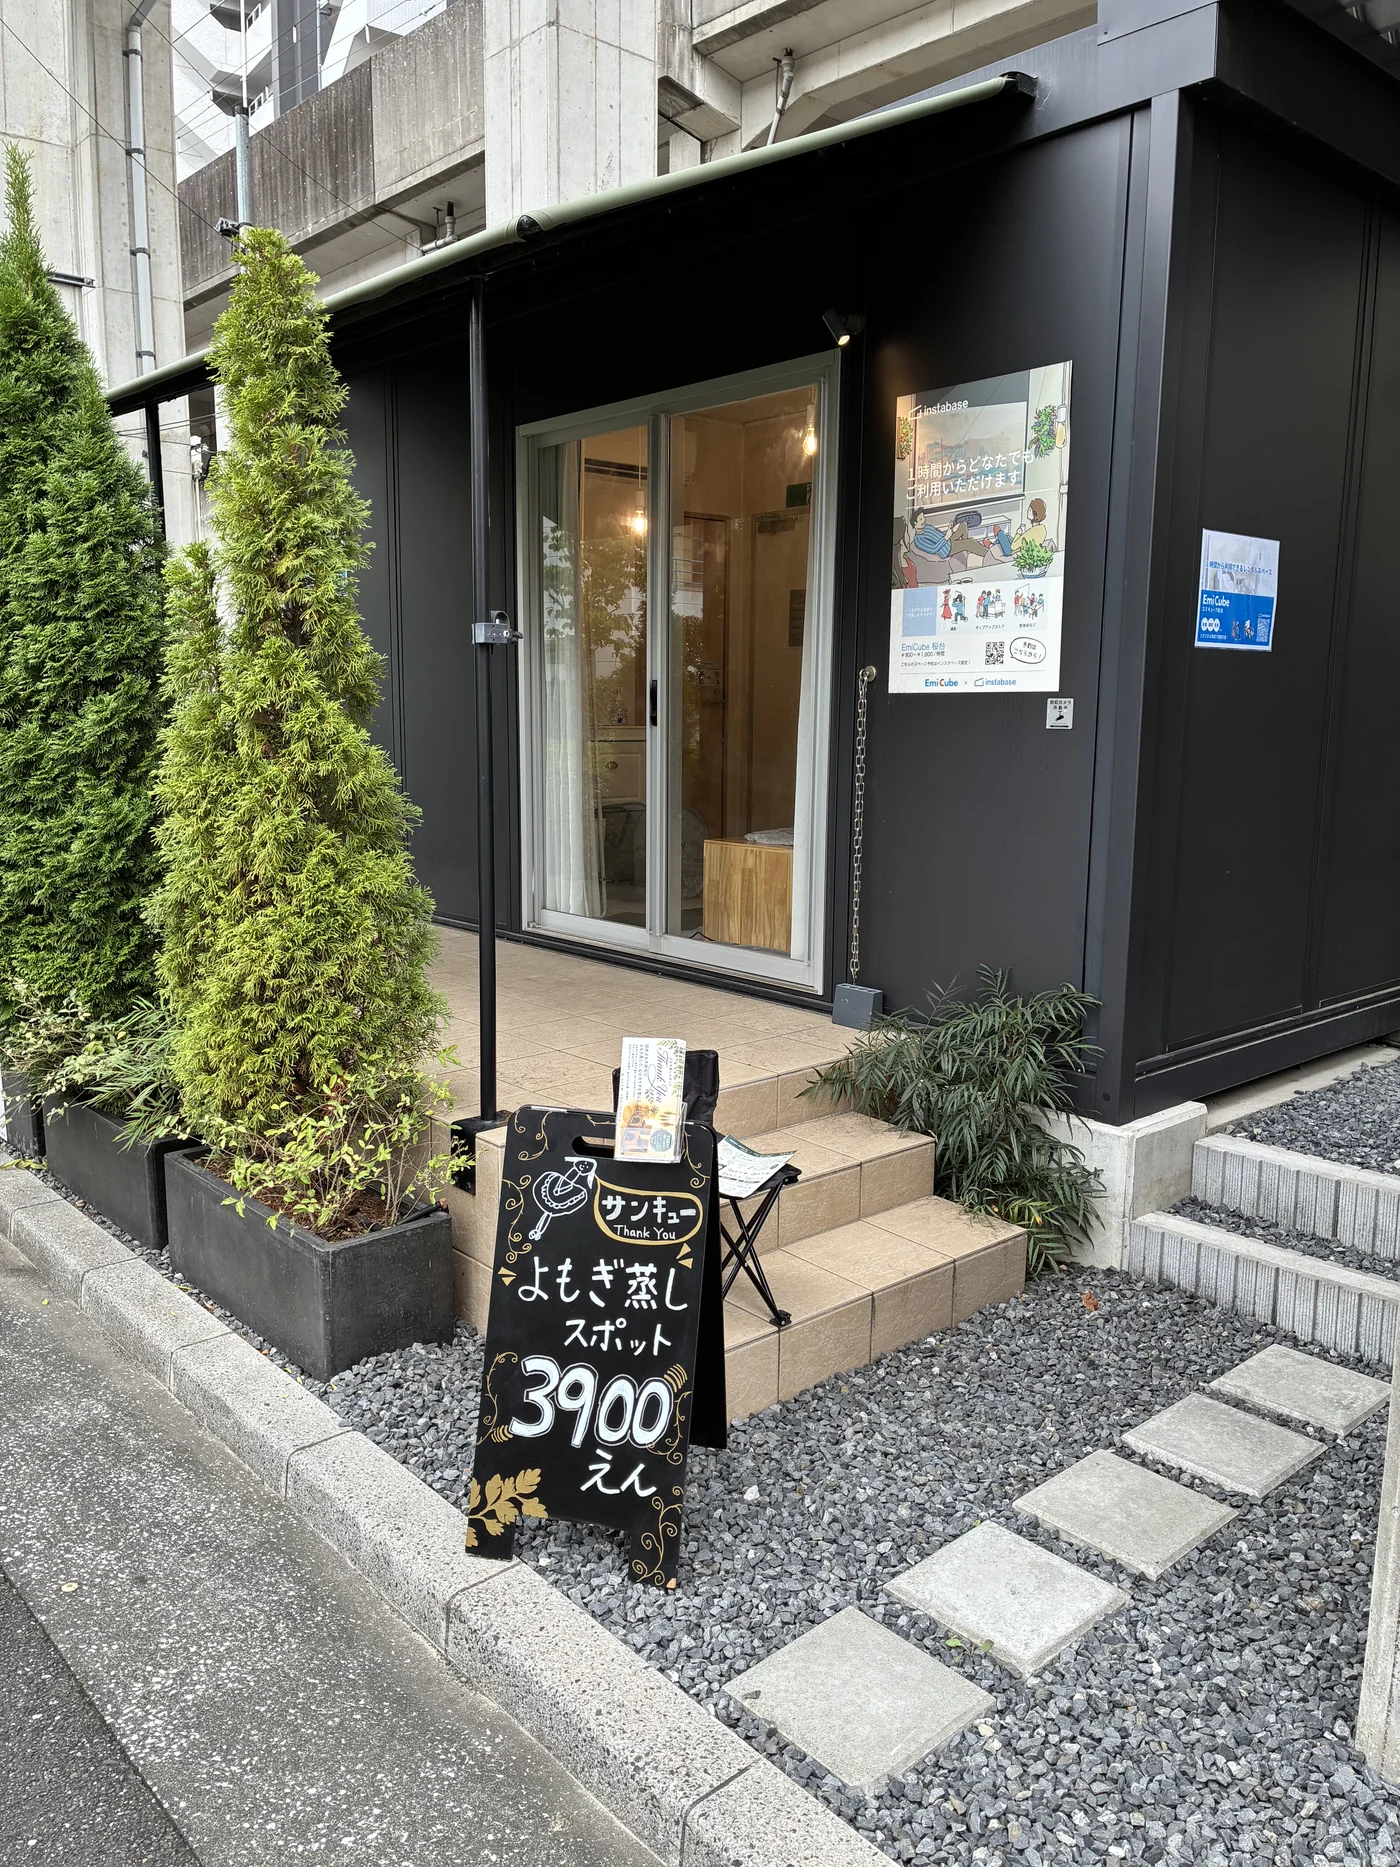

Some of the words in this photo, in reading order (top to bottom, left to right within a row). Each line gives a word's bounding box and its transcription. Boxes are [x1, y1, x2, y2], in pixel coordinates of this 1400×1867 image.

[923, 399, 969, 415] instabase
[908, 450, 1034, 481] 1時間からどなたでも
[906, 470, 1021, 500] ご利用いただけます
[901, 643, 930, 651] EmiCube
[985, 677, 1017, 687] instabase
[601, 1194, 697, 1226] サンキュー
[613, 1224, 651, 1239] Thank
[653, 1225, 677, 1241] You
[517, 1256, 689, 1311] よもぎ蒸し
[563, 1318, 672, 1356] スポット
[508, 1354, 675, 1448] 3900
[579, 1448, 658, 1498] えん
